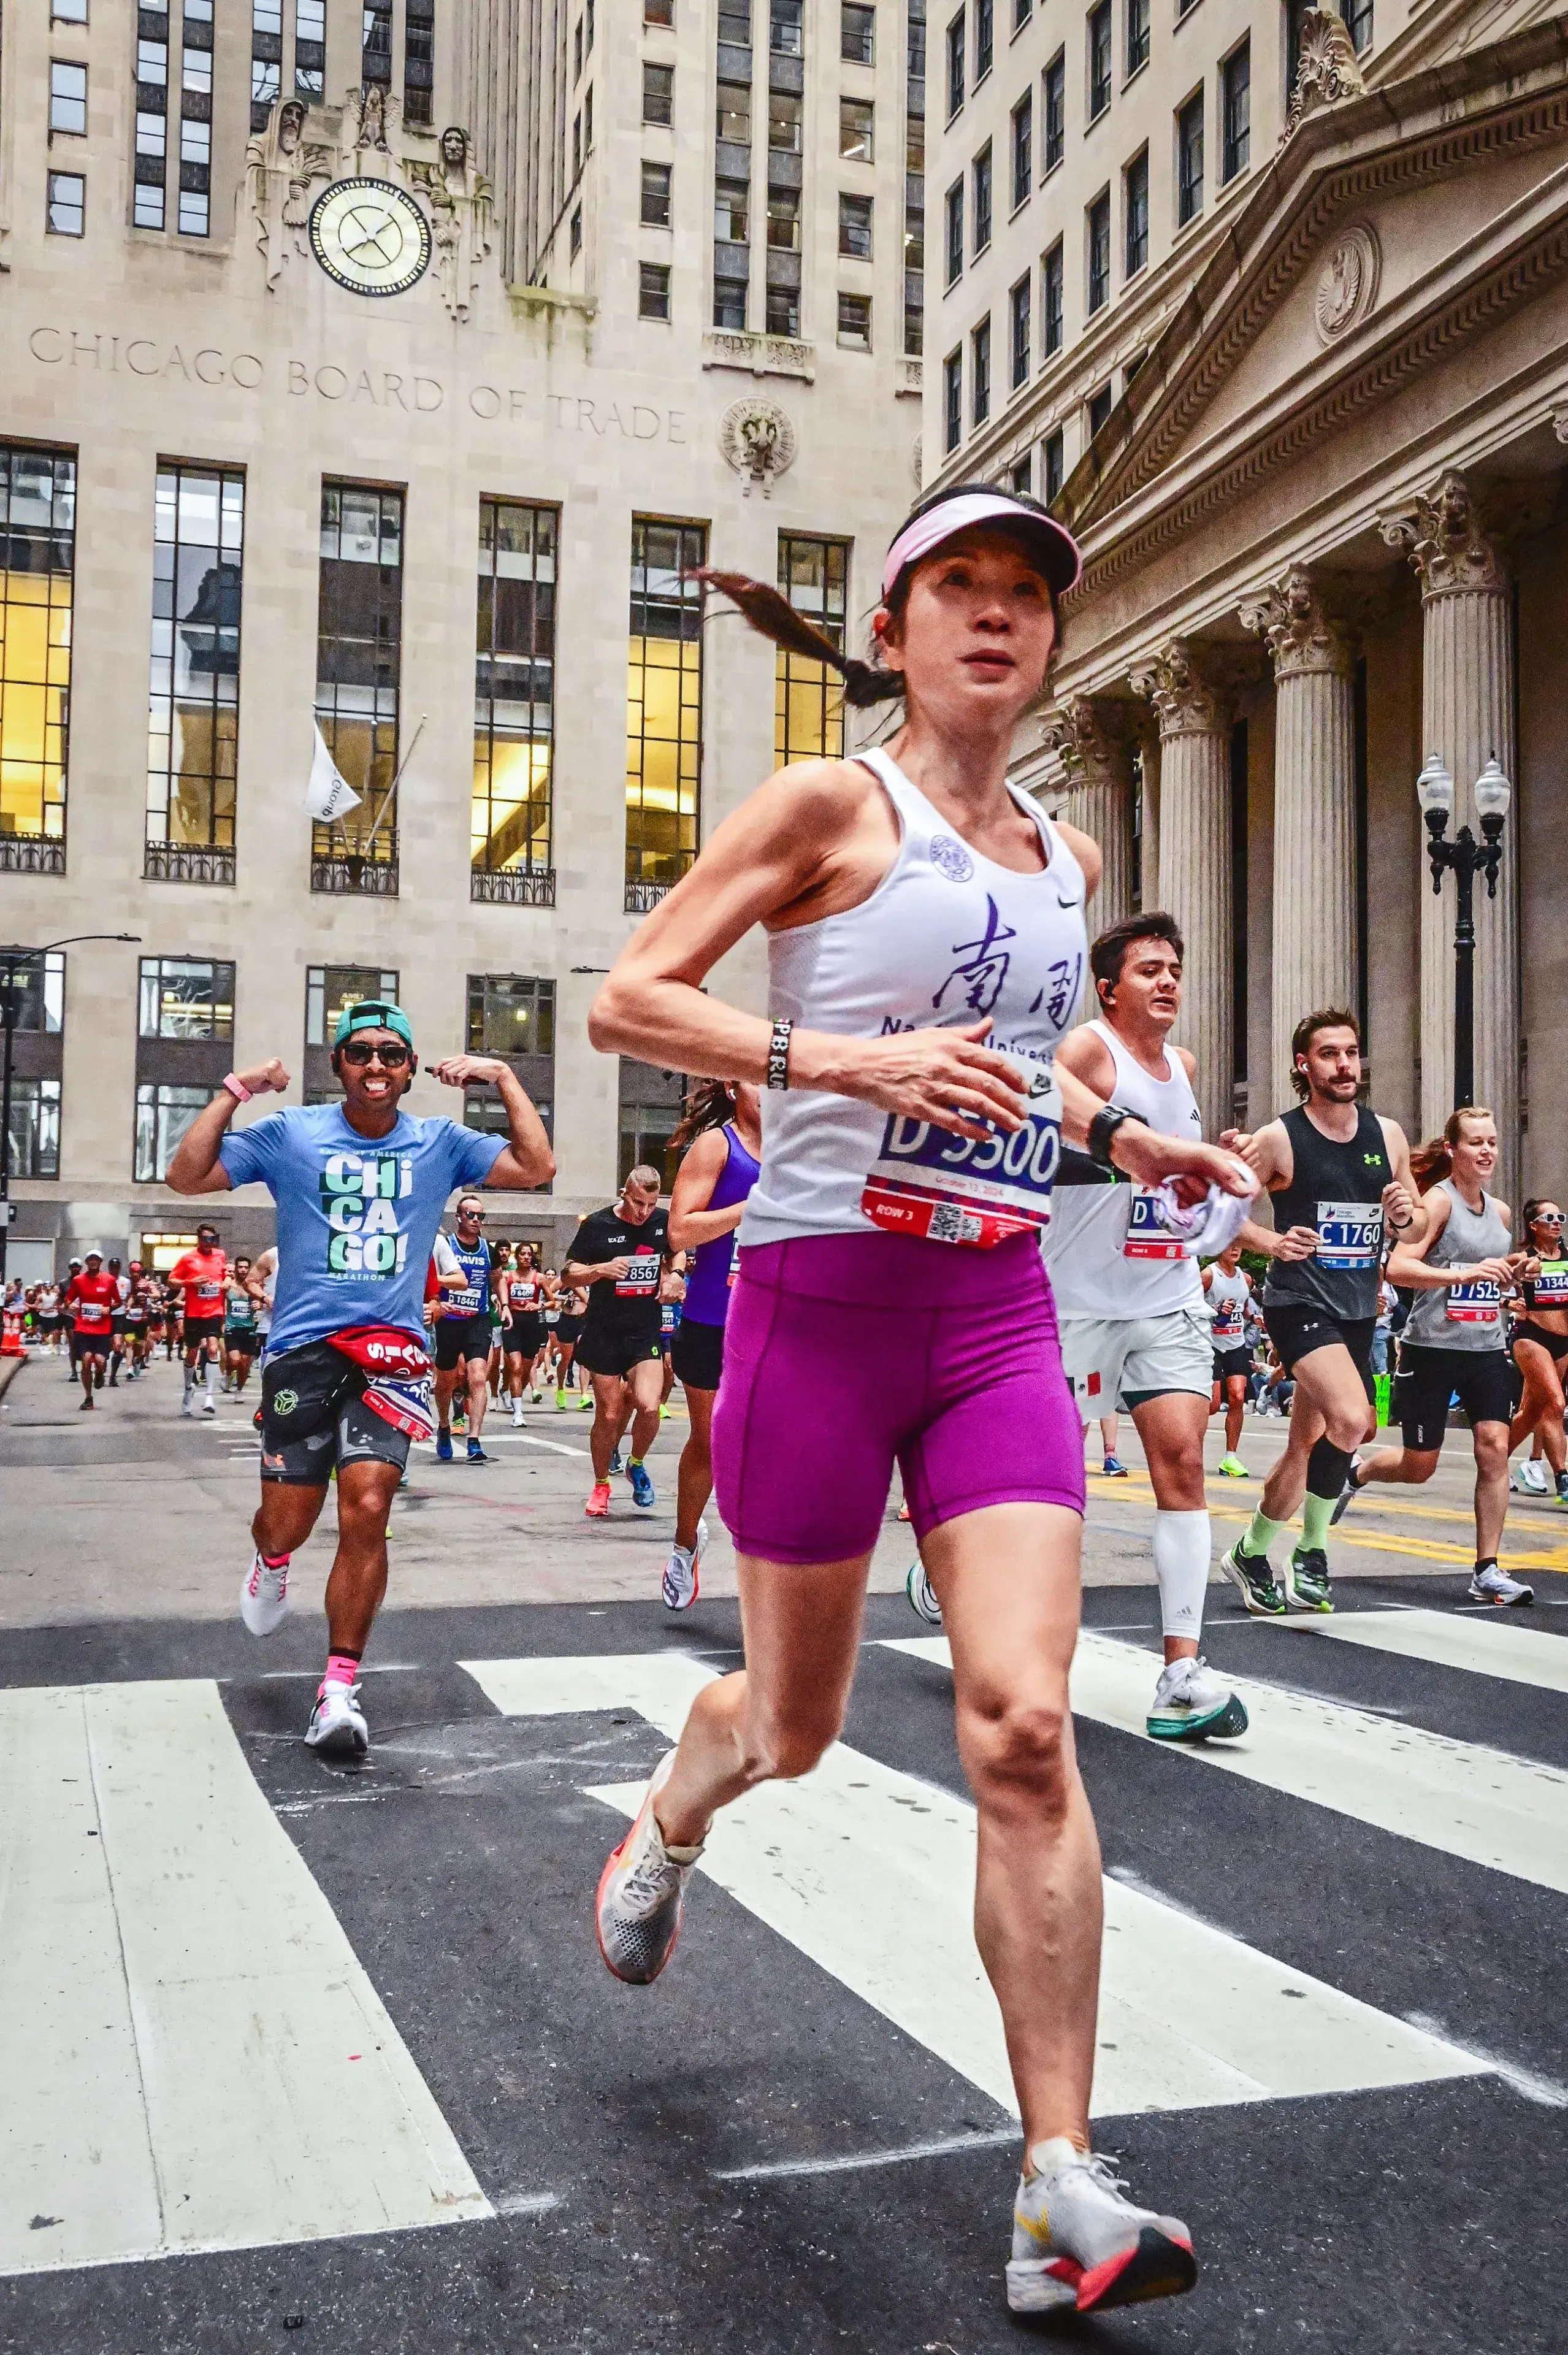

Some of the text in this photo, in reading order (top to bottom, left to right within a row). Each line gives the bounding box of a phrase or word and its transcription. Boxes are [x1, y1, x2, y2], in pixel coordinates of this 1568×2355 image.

[28, 327, 687, 444] CHICAGO BOARD OF TRADE
[889, 1114, 930, 1153] D
[329, 1195, 400, 1233] CA
[876, 1203, 914, 1220] ROW 3
[1133, 1201, 1148, 1223] D
[1319, 1223, 1380, 1245] C 1760
[329, 1233, 409, 1274] GO!
[454, 1255, 485, 1266] DAVIS
[630, 1266, 659, 1280] 8567
[1534, 1279, 1542, 1289] D
[456, 1296, 478, 1306] 18461
